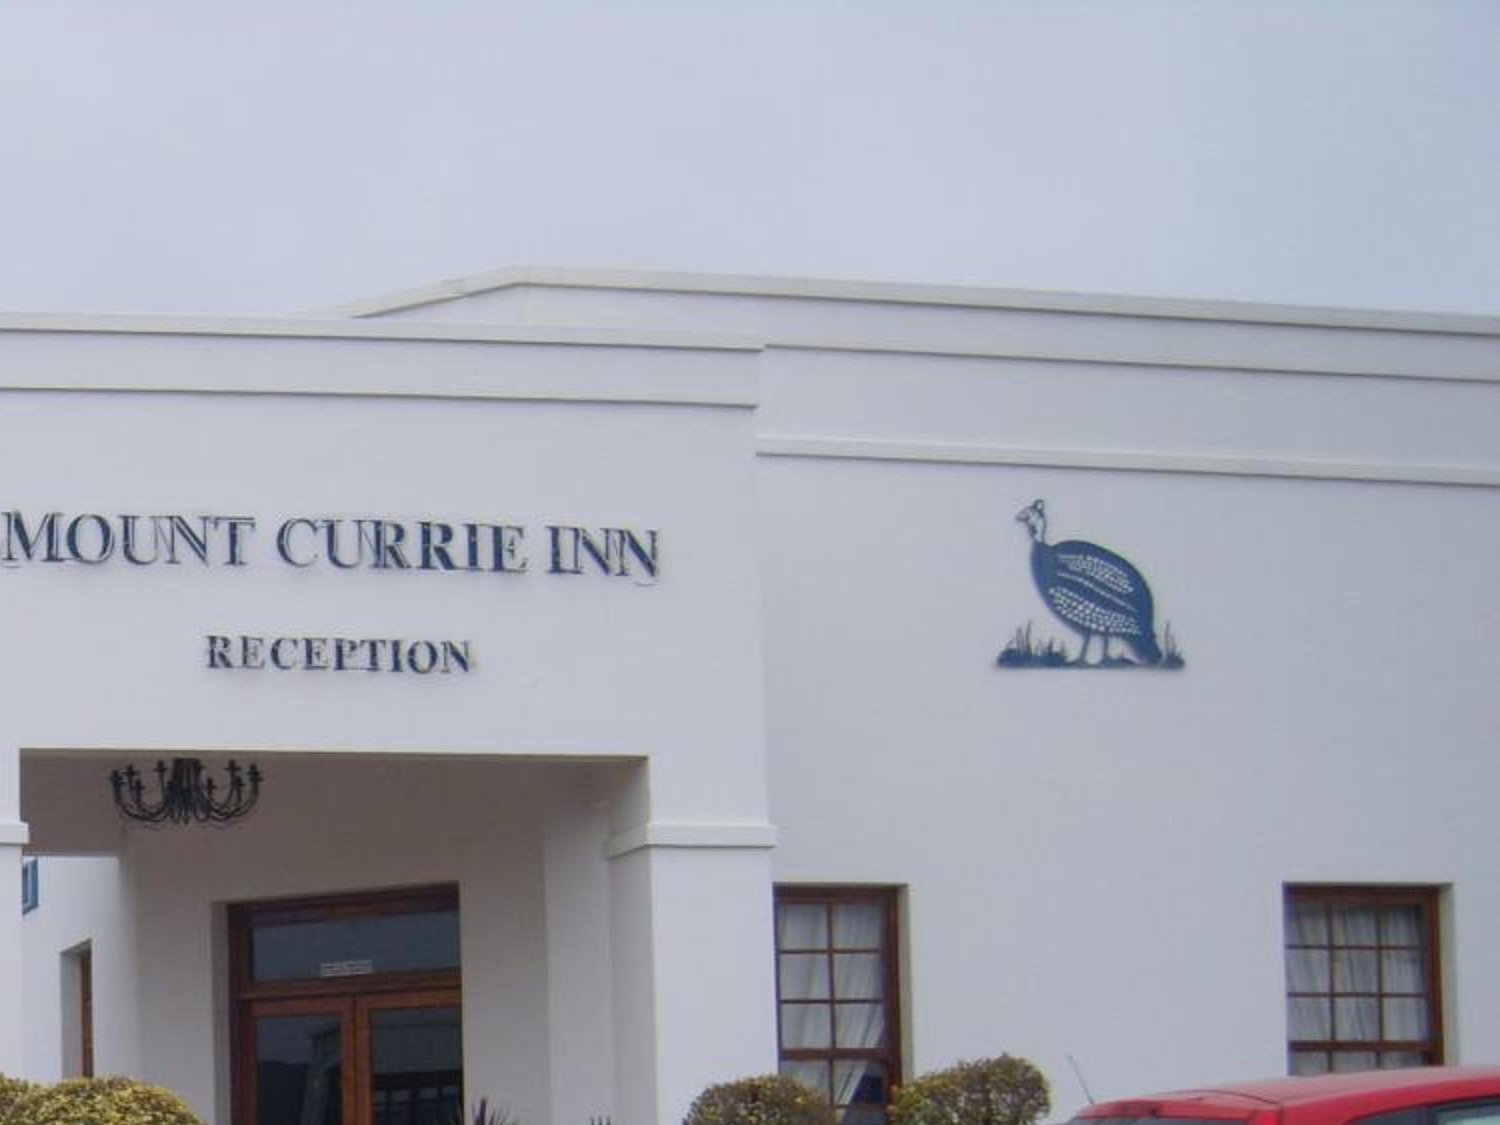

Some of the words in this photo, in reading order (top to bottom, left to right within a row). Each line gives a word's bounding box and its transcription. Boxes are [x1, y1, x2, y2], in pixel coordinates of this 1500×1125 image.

[0, 510, 256, 566] MOUNT
[276, 517, 530, 573] CURRIE
[545, 524, 660, 578] INN
[205, 634, 471, 675] RECEPTION
